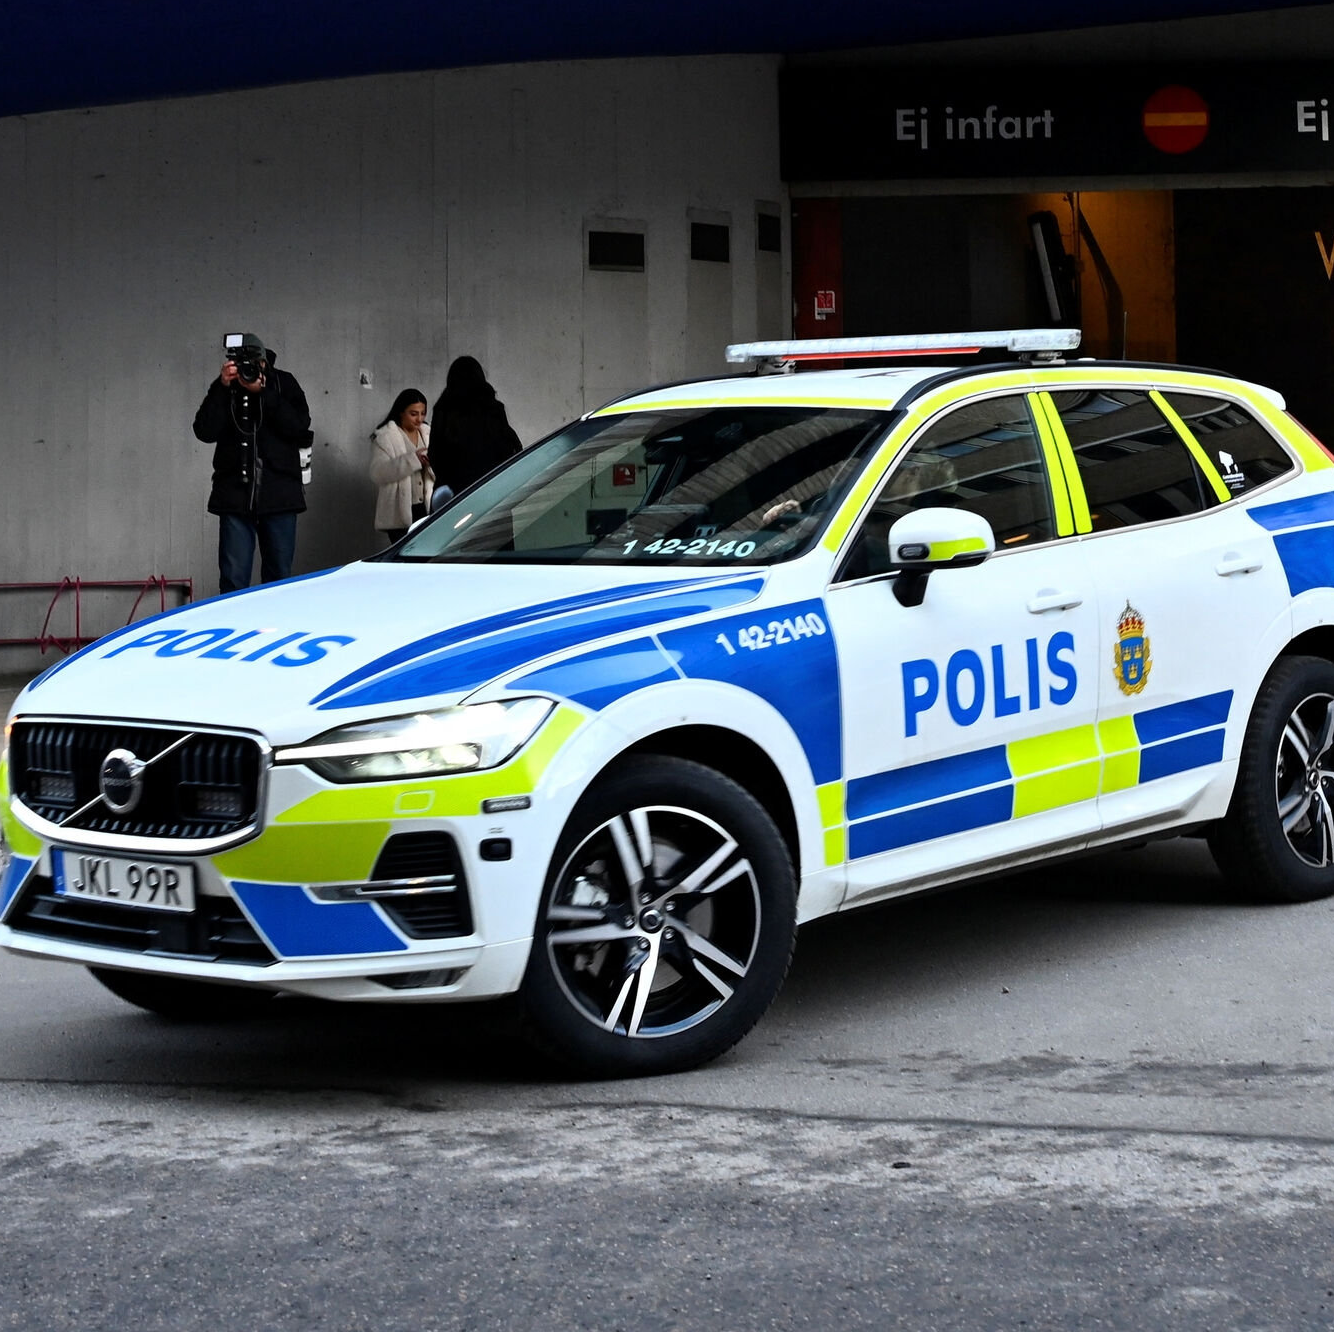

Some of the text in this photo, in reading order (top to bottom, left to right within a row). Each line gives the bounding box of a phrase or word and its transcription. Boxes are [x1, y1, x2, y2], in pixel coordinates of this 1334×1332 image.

[895, 105, 1055, 149] Ej infart
[1296, 98, 1330, 141] Ej
[622, 538, 756, 558] 1 42-2140
[99, 628, 358, 668] POLIS
[715, 612, 827, 656] 1 42-2140
[901, 631, 1078, 738] POLIS
[72, 855, 182, 906] JKL 99R
